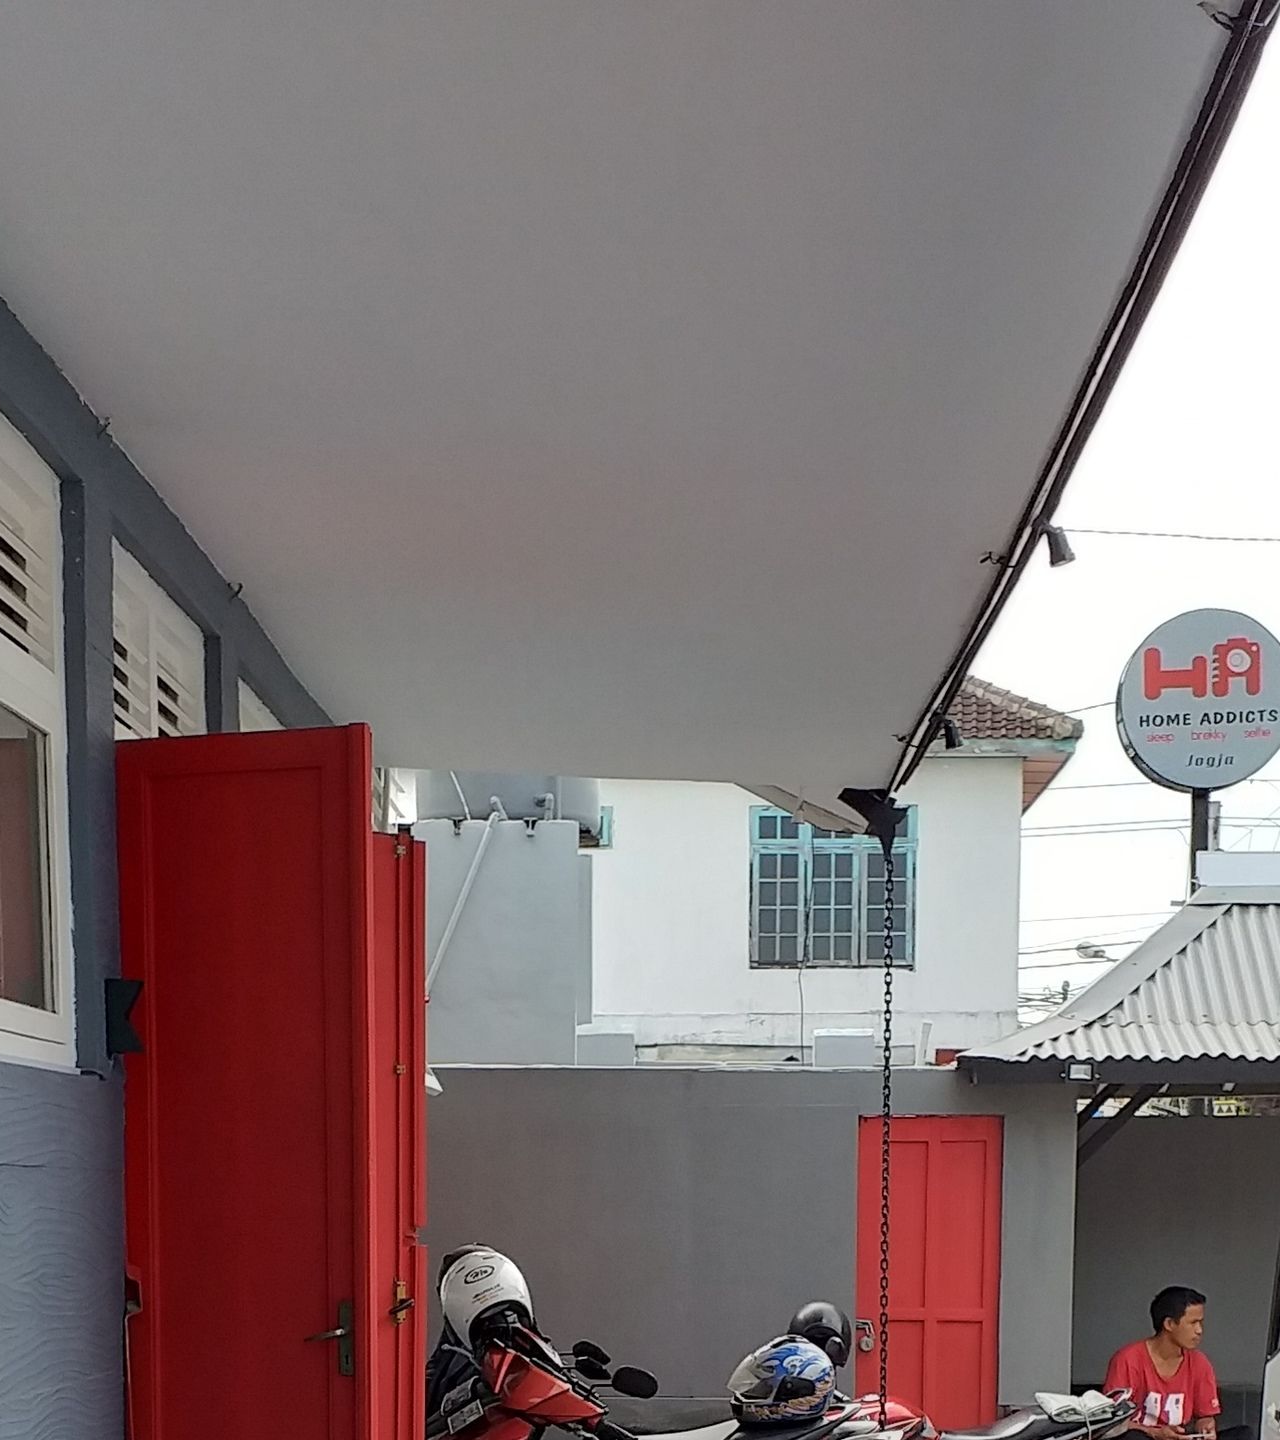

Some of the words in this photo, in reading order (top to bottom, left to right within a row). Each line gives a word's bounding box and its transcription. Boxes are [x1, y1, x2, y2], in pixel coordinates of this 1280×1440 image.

[1139, 712, 1192, 728] HOME
[1199, 708, 1280, 725] ADDICTS
[1146, 732, 1176, 743] sleep
[1190, 728, 1228, 743] brekky
[1243, 727, 1272, 739] selfie
[1185, 753, 1235, 769] Jogja
